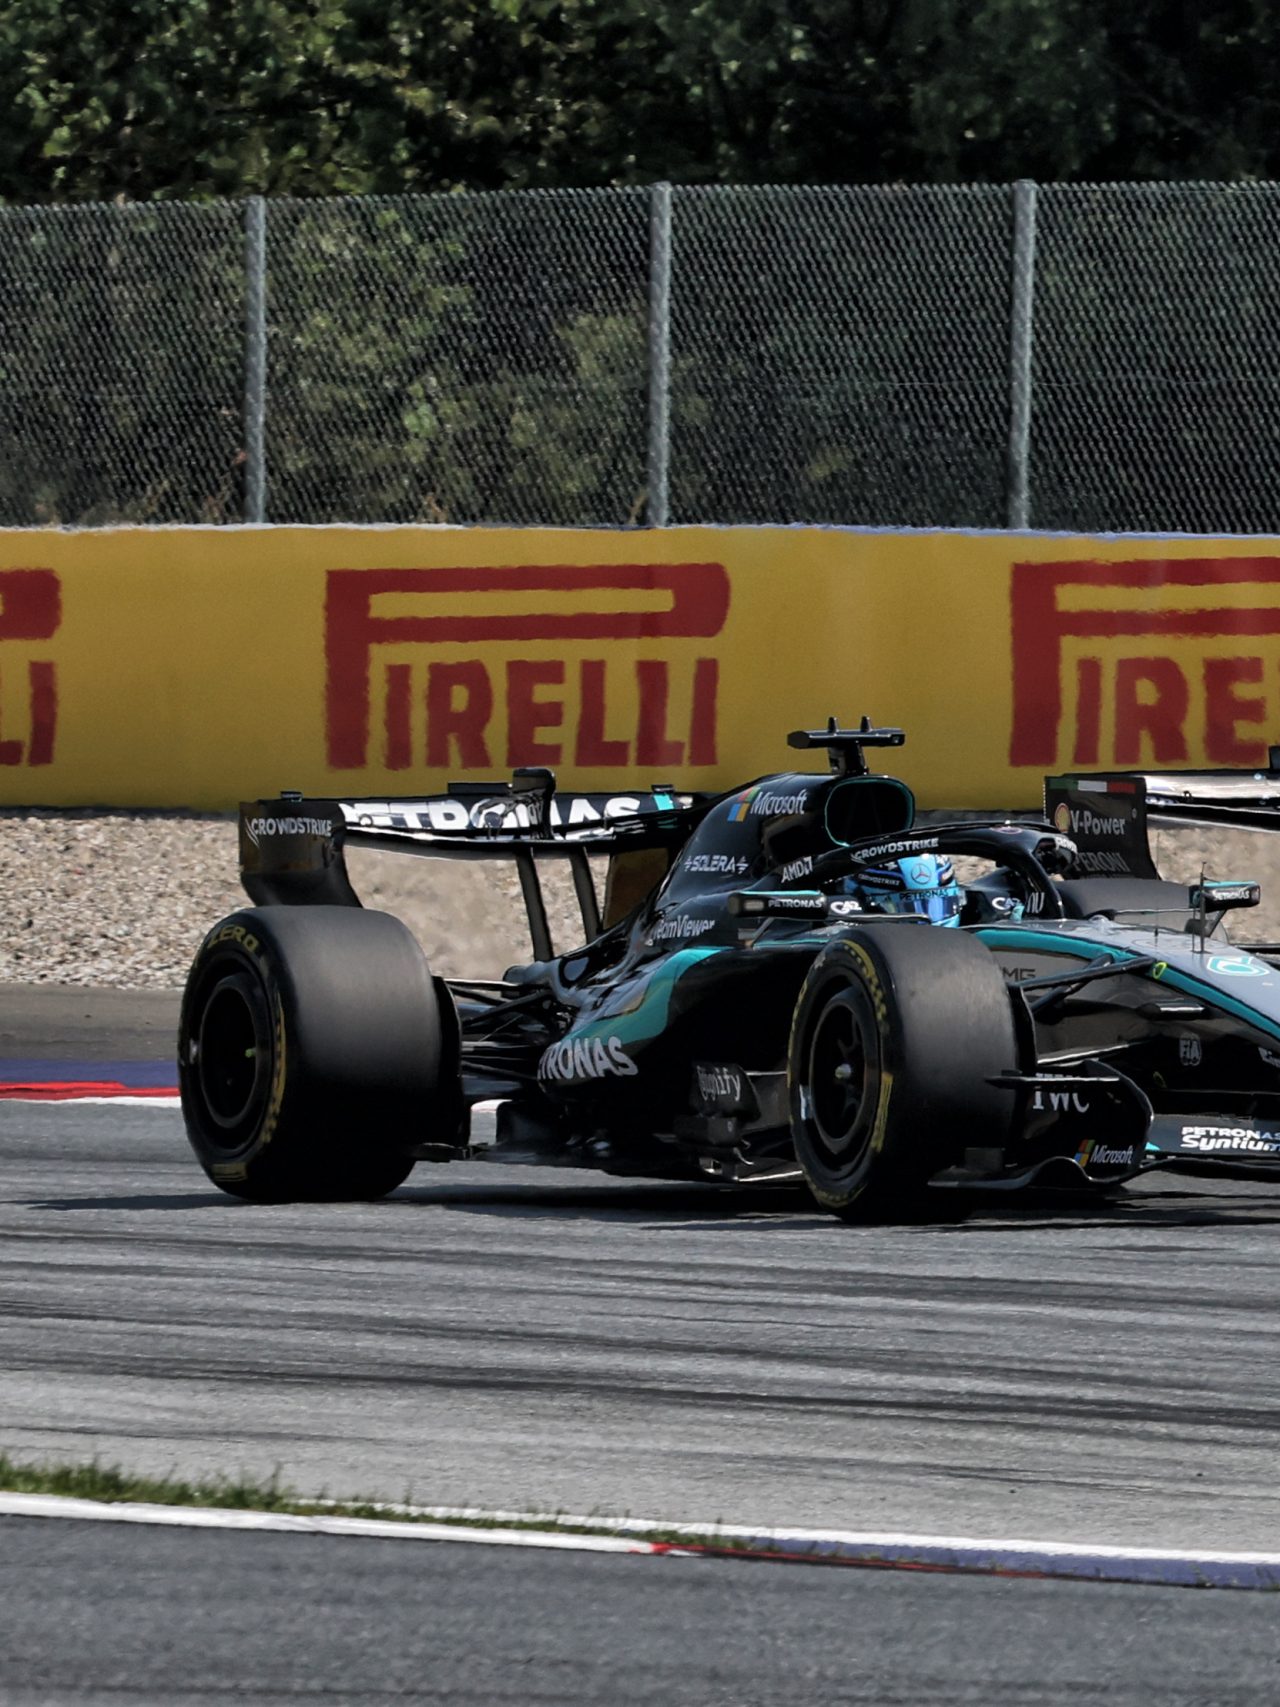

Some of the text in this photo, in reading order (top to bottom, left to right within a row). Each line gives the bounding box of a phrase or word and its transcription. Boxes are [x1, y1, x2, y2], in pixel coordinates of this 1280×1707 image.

[325, 562, 730, 770] PIRELLI
[751, 790, 807, 815] Microsoft
[251, 816, 332, 837] CROWDSTRIKE
[1070, 810, 1126, 836] V-Power
[855, 838, 939, 860] CROWDSTRIKE
[691, 855, 736, 873] SOLERA
[781, 861, 805, 884] AMD
[768, 900, 822, 909] PETRONAS
[207, 925, 259, 952] ZERO
[1032, 1087, 1091, 1114] IWC
[1090, 1144, 1134, 1164] Microsoft
